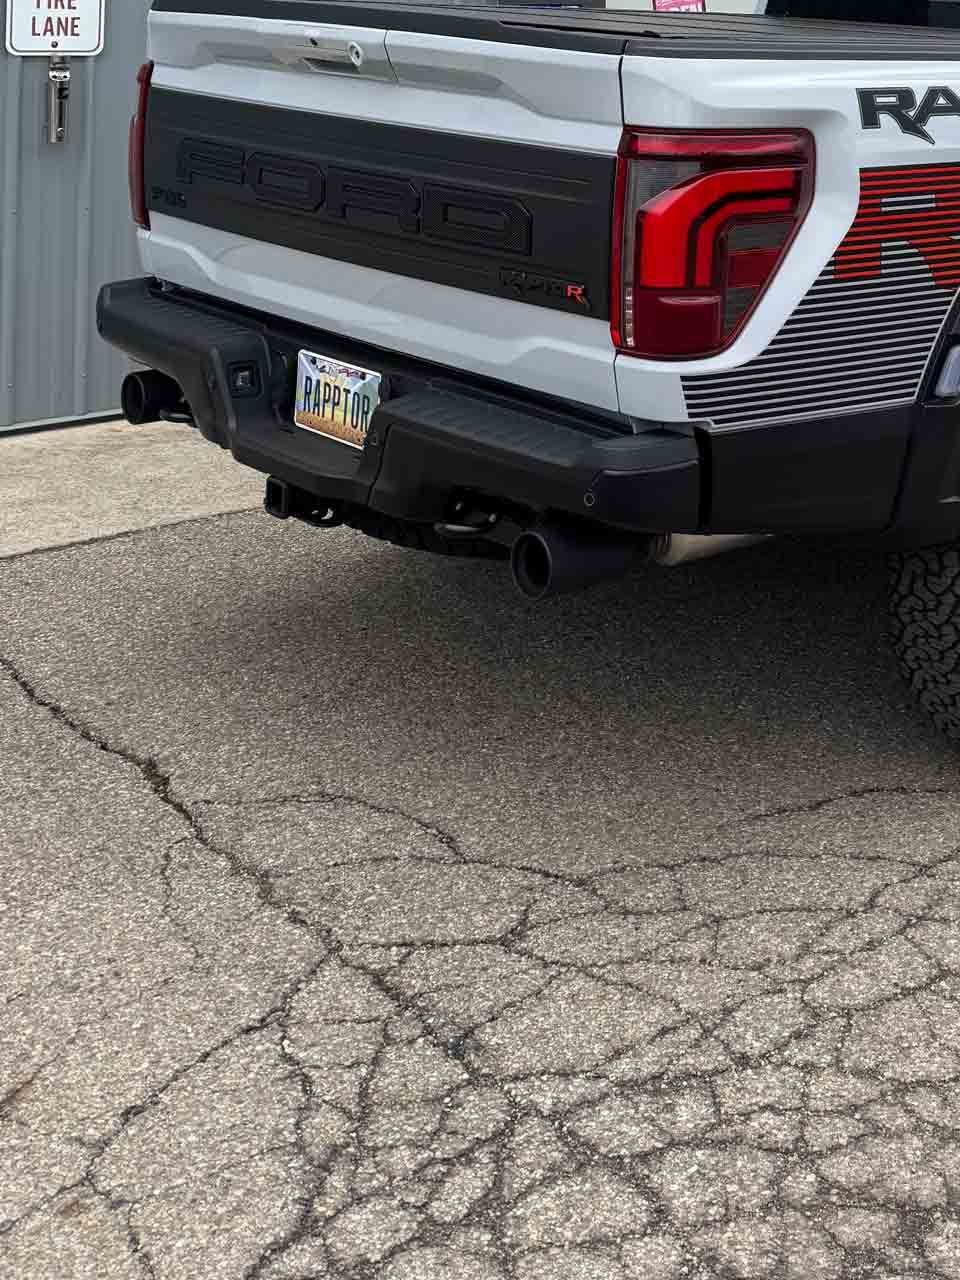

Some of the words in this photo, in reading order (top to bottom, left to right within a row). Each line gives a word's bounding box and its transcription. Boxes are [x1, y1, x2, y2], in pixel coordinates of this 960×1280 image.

[31, 16, 81, 37] LANE
[178, 136, 534, 257] FORD
[303, 375, 370, 433] RAPPTOR
